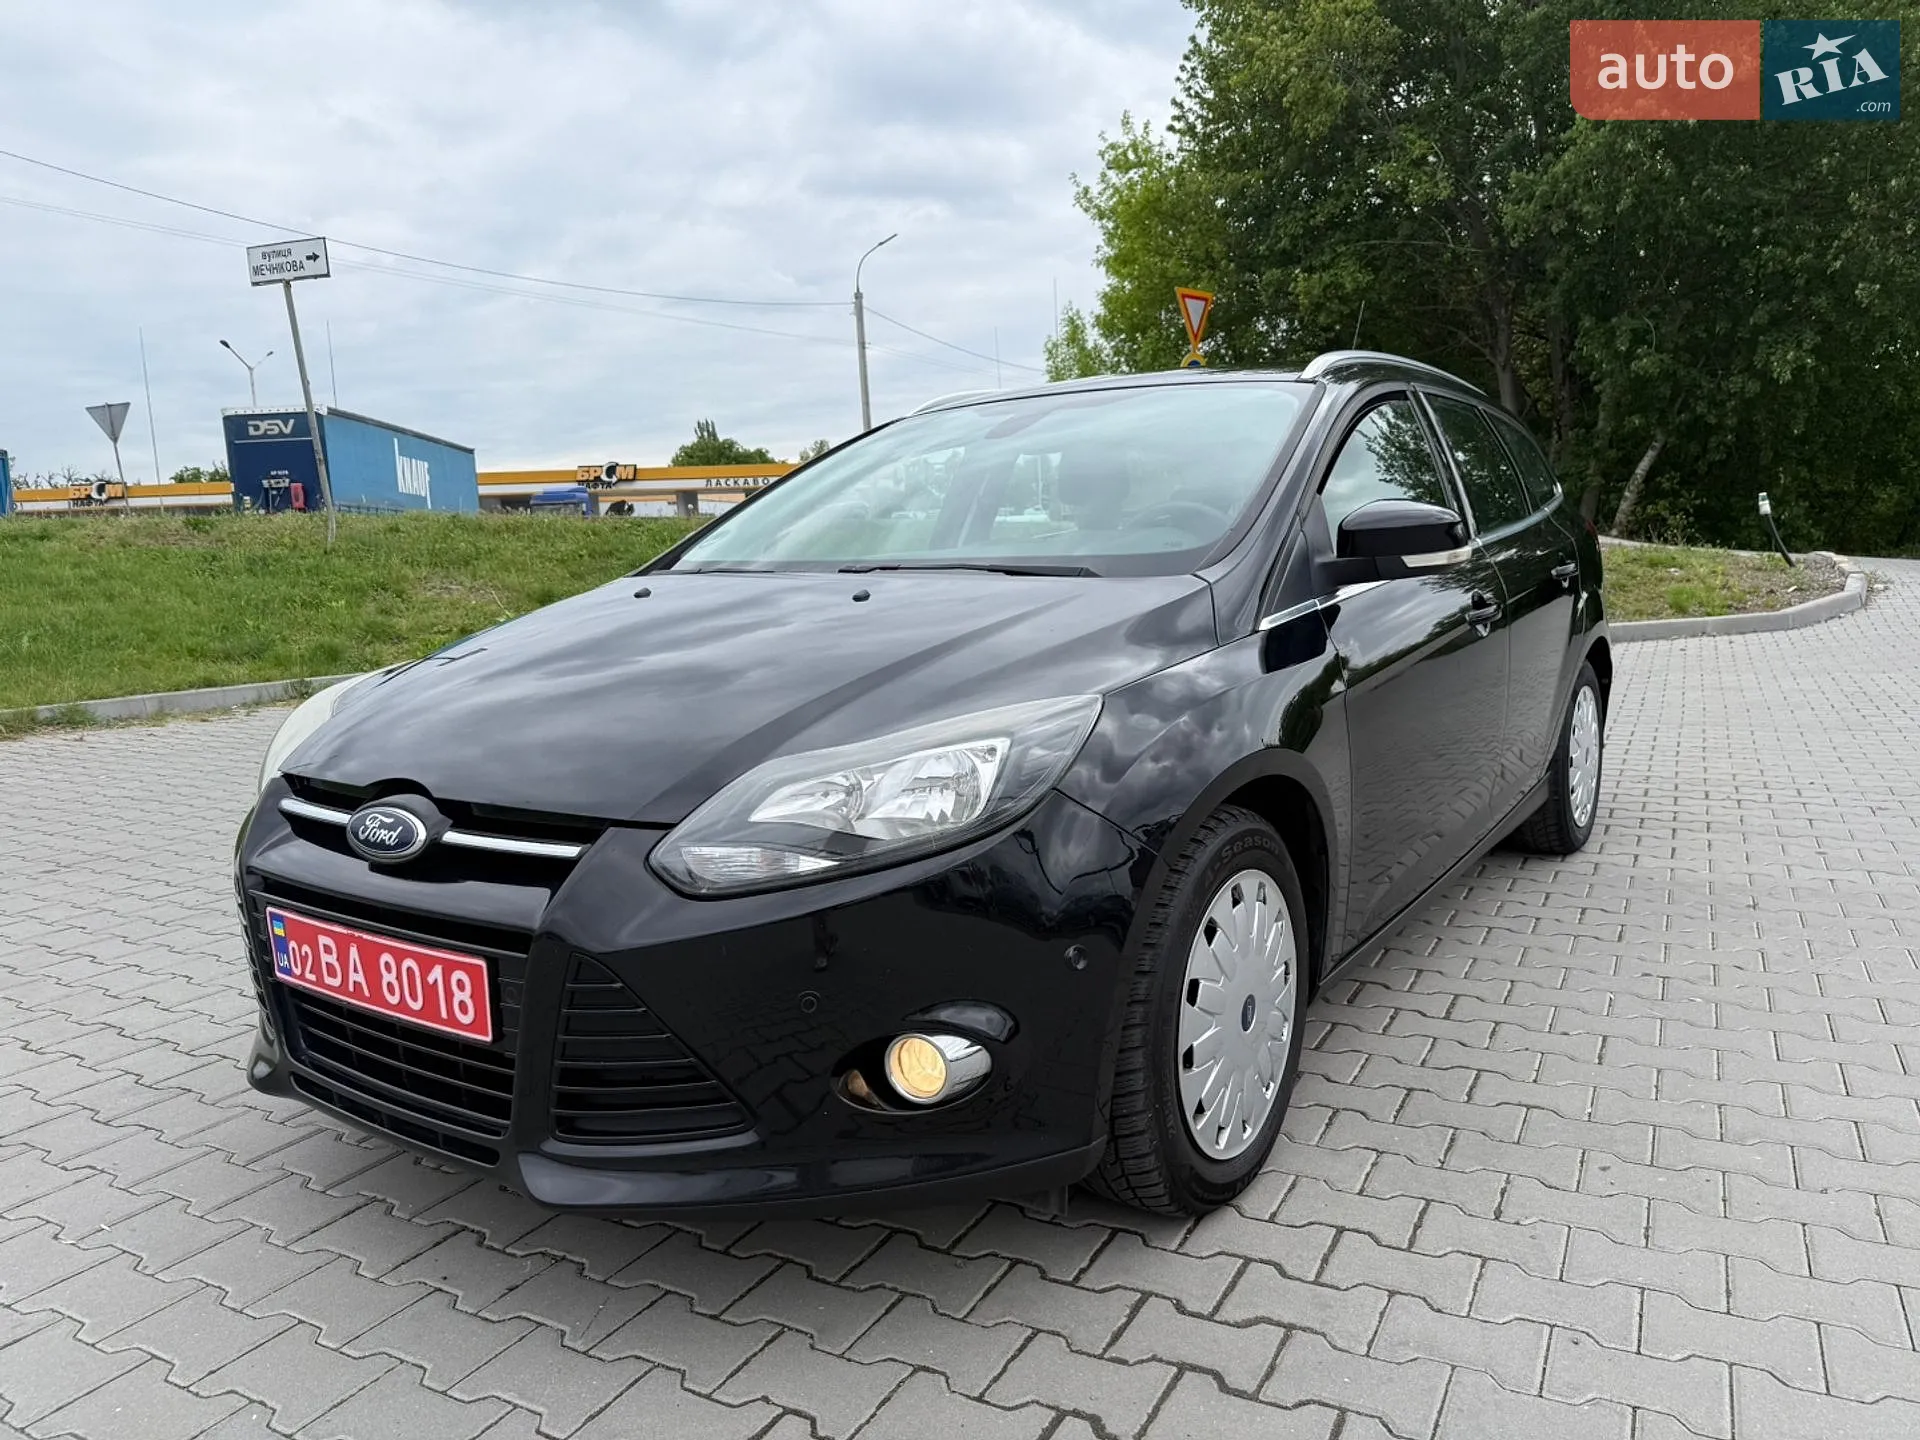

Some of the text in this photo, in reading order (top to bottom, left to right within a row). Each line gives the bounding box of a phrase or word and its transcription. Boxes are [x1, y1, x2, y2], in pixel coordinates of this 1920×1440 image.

[261, 248, 292, 262] вулиця
[252, 260, 305, 276] МЕЧНІКОВА
[247, 418, 295, 436] DSV
[393, 437, 432, 509] KNAUF
[705, 477, 770, 487] ЛАСКАВО
[358, 812, 401, 847] Ford
[277, 951, 290, 969] UA
[379, 952, 476, 1026] 8018
